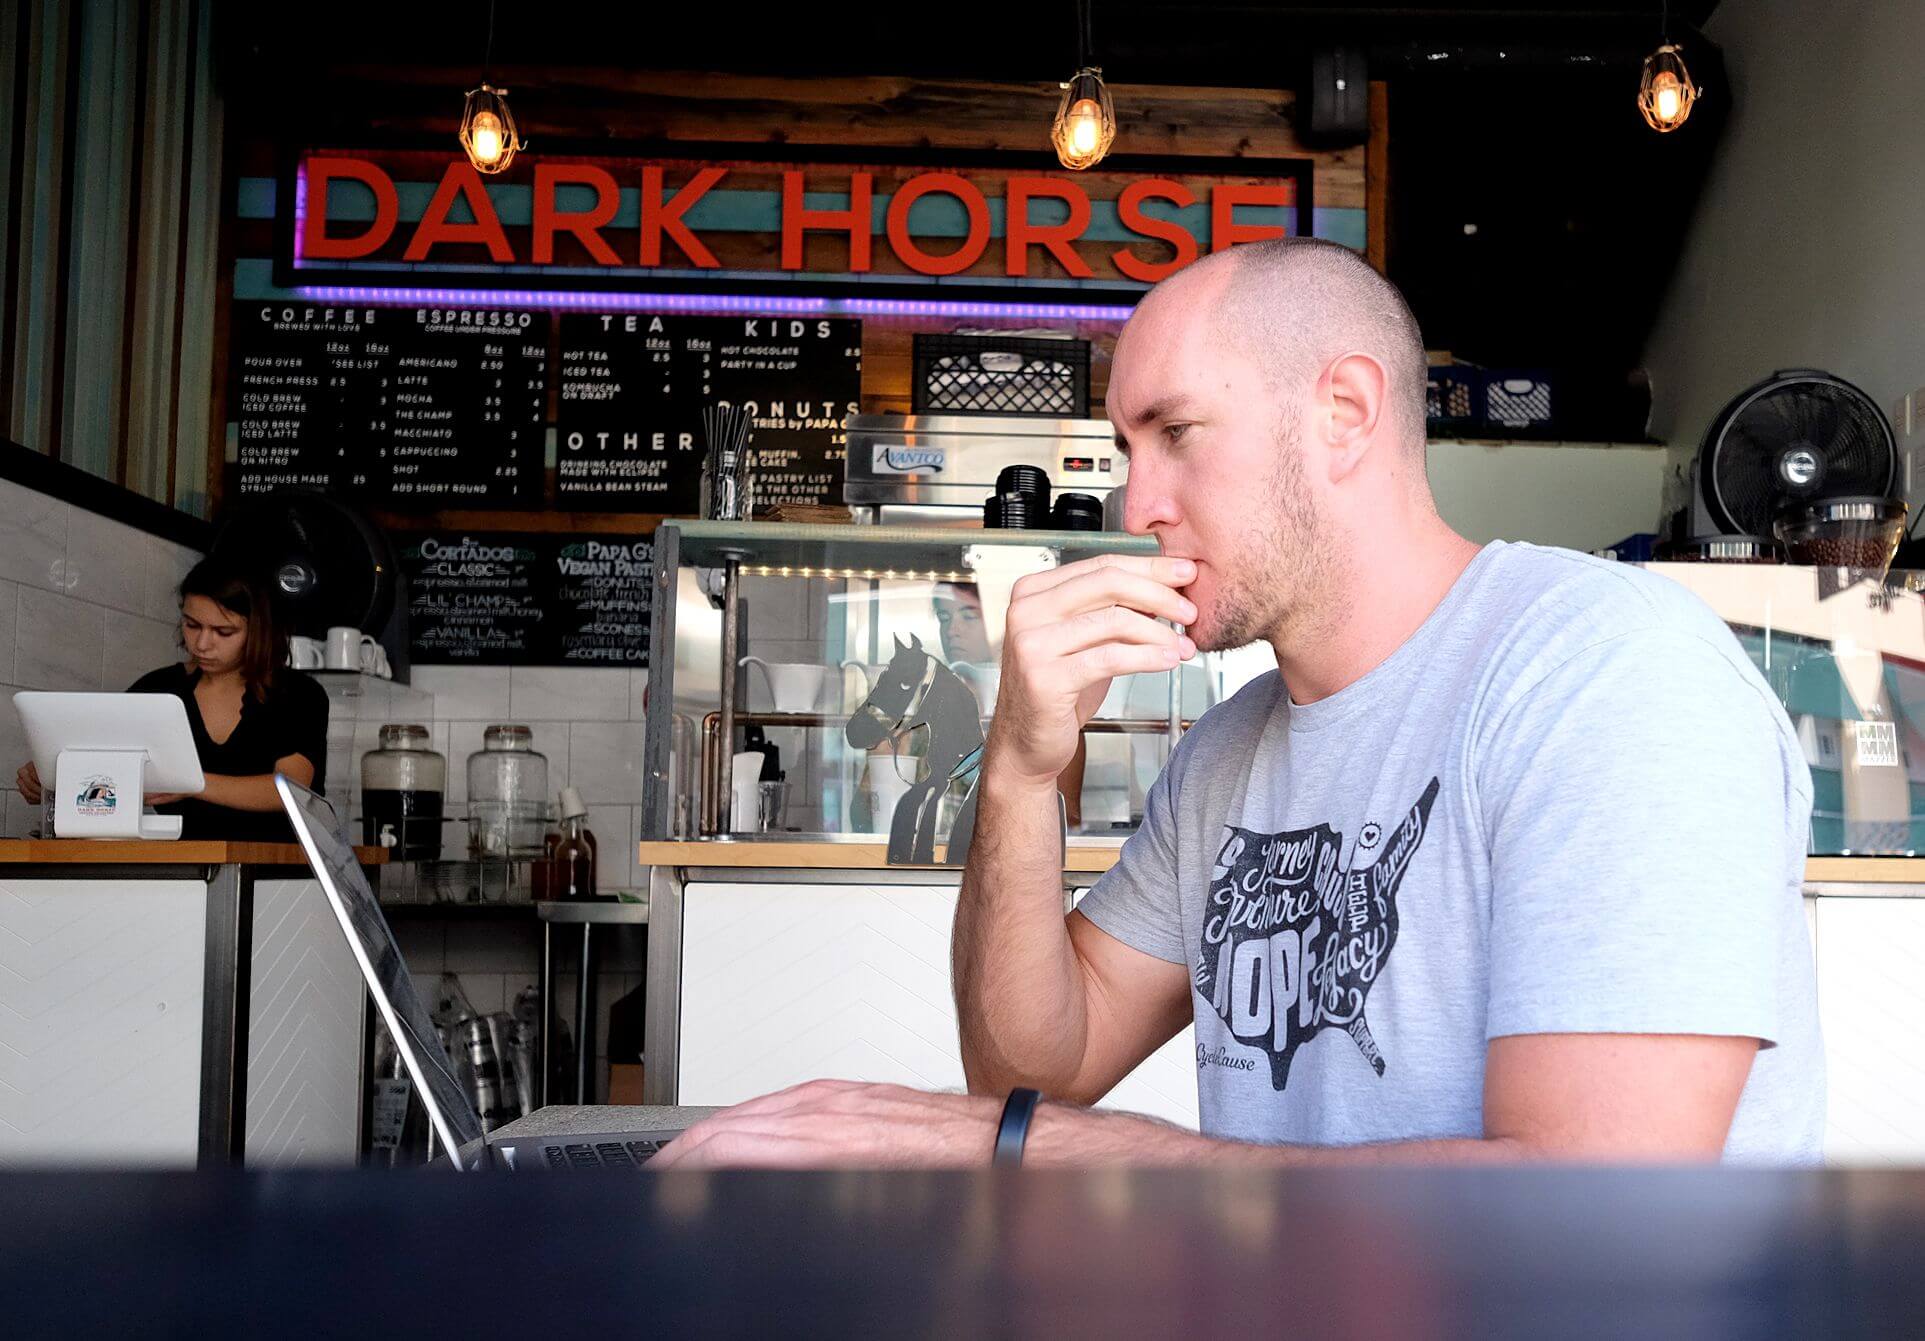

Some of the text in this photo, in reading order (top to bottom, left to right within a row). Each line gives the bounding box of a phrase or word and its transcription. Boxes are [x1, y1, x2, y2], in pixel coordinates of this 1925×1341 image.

[303, 157, 729, 268] DARK
[260, 307, 376, 324] COFFEE
[416, 309, 532, 327] ESPRESSO
[600, 315, 664, 333] TEA
[744, 320, 831, 338] KIDS
[563, 350, 584, 361] HOT
[587, 351, 609, 361] TEA
[275, 356, 303, 368] OVER
[399, 357, 458, 369] AMERICANO
[720, 359, 753, 369] PARTY
[754, 360, 766, 369] IN
[767, 361, 775, 369] A
[776, 360, 798, 370] CUP
[562, 366, 588, 377] ICED
[590, 367, 611, 377] TEA
[243, 375, 284, 385] FRENCH
[285, 376, 319, 386] PRESS
[397, 375, 429, 386] LATTE
[243, 394, 271, 403] COLD
[396, 393, 433, 404] MOCHA
[242, 402, 308, 413] ICED COFFEE
[395, 409, 415, 420] THE
[416, 410, 453, 420] CHAMP
[242, 419, 269, 429] COLD
[788, 417, 803, 430] by
[804, 418, 839, 429] PAPA
[241, 429, 298, 439] ICED LATTE
[394, 427, 453, 438] MACCHIATO
[567, 431, 694, 451] OTHER
[241, 446, 268, 456] COLD
[393, 446, 458, 457] CAPPUCCINO
[393, 464, 420, 475] SHOT
[240, 474, 262, 484] ADD
[264, 474, 298, 484] HOUSE
[300, 474, 330, 485] MADE
[759, 473, 805, 483] PASTRY
[808, 474, 834, 483] LIST
[392, 483, 414, 493] ADD
[415, 483, 450, 493] SHORT
[451, 483, 488, 494] ROUND
[560, 481, 669, 492] VANILLA BEAN STEAM
[587, 541, 631, 561] PAPA
[437, 562, 495, 576] CLASSIC
[557, 556, 612, 576] VEGAN
[455, 593, 505, 608] CHAMP
[591, 600, 648, 612] MUFFINS
[436, 626, 497, 640] VANILLA
[578, 648, 650, 660] COFFEE CAK
[1348, 873, 1369, 933] HELP
